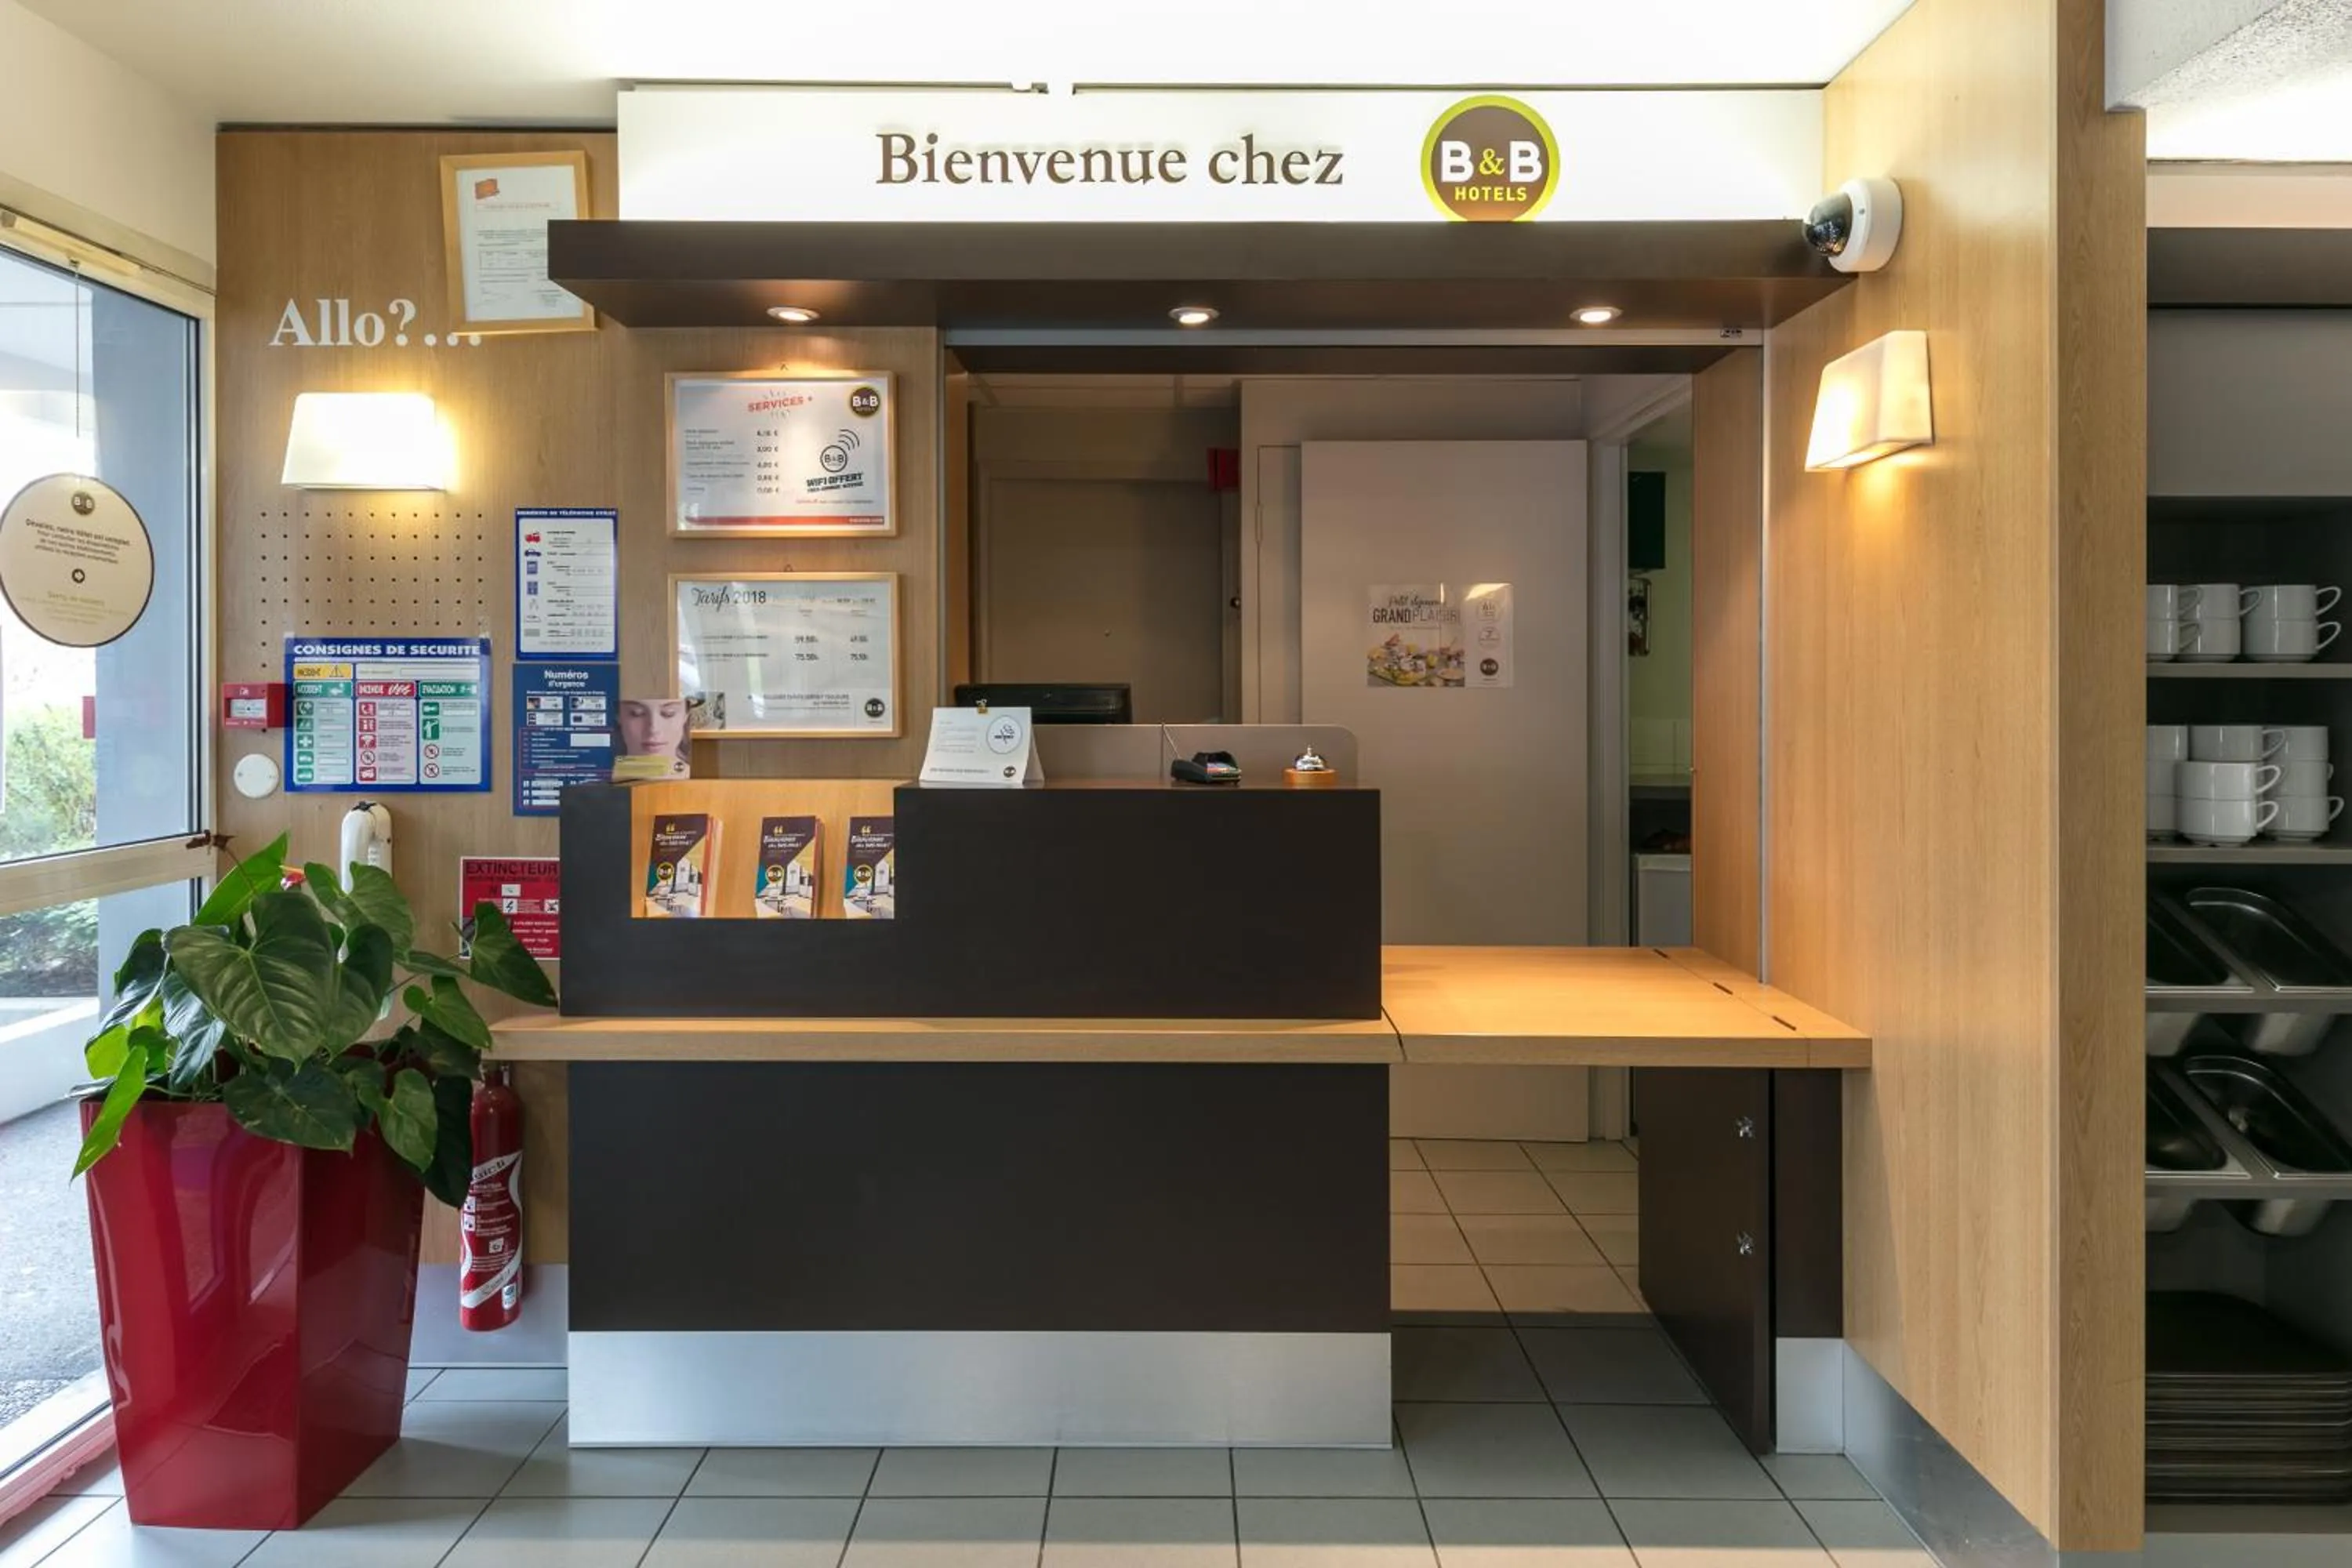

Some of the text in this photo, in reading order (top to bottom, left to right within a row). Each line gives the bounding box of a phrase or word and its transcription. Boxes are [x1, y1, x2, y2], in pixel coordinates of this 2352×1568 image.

[876, 132, 1344, 185] Bienvenue chez
[1454, 187, 1527, 201] HOTELS
[747, 396, 804, 412] SERVICES
[691, 586, 767, 612] Tarifs 2018
[293, 645, 382, 655] CONSIGNES
[386, 645, 407, 655] DE
[544, 670, 589, 680] Numéros
[466, 862, 558, 875] EXTINCTEUR
